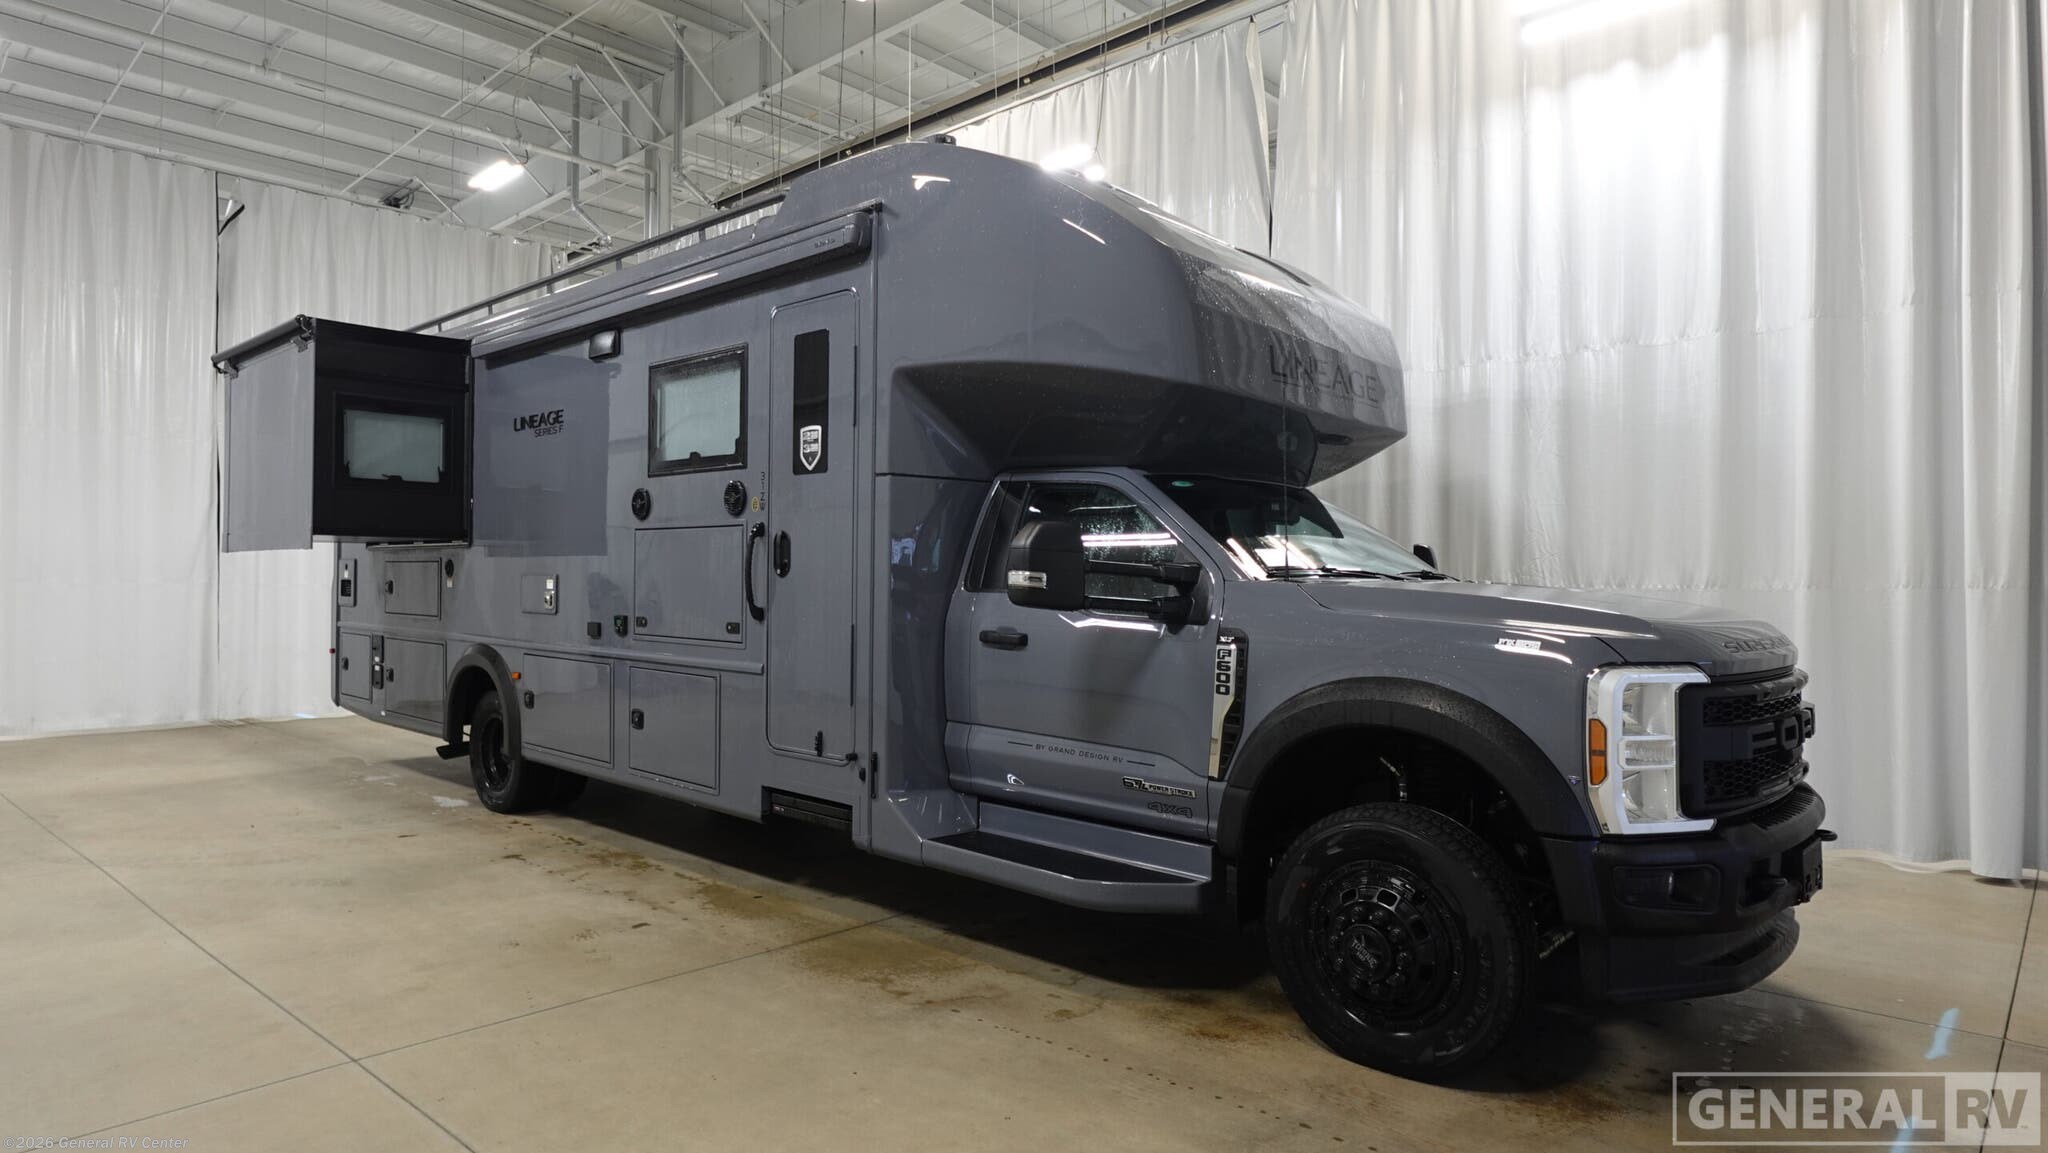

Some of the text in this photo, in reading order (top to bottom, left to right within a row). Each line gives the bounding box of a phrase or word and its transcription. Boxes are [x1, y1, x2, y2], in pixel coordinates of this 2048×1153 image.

[1269, 344, 1379, 403] LINEAGE
[513, 409, 564, 432] LINEAGE
[534, 426, 558, 438] SERIES
[1215, 648, 1231, 696] F600
[1035, 743, 1046, 751] BY
[1048, 745, 1076, 756] GRAND
[1078, 749, 1110, 761] DESIGN
